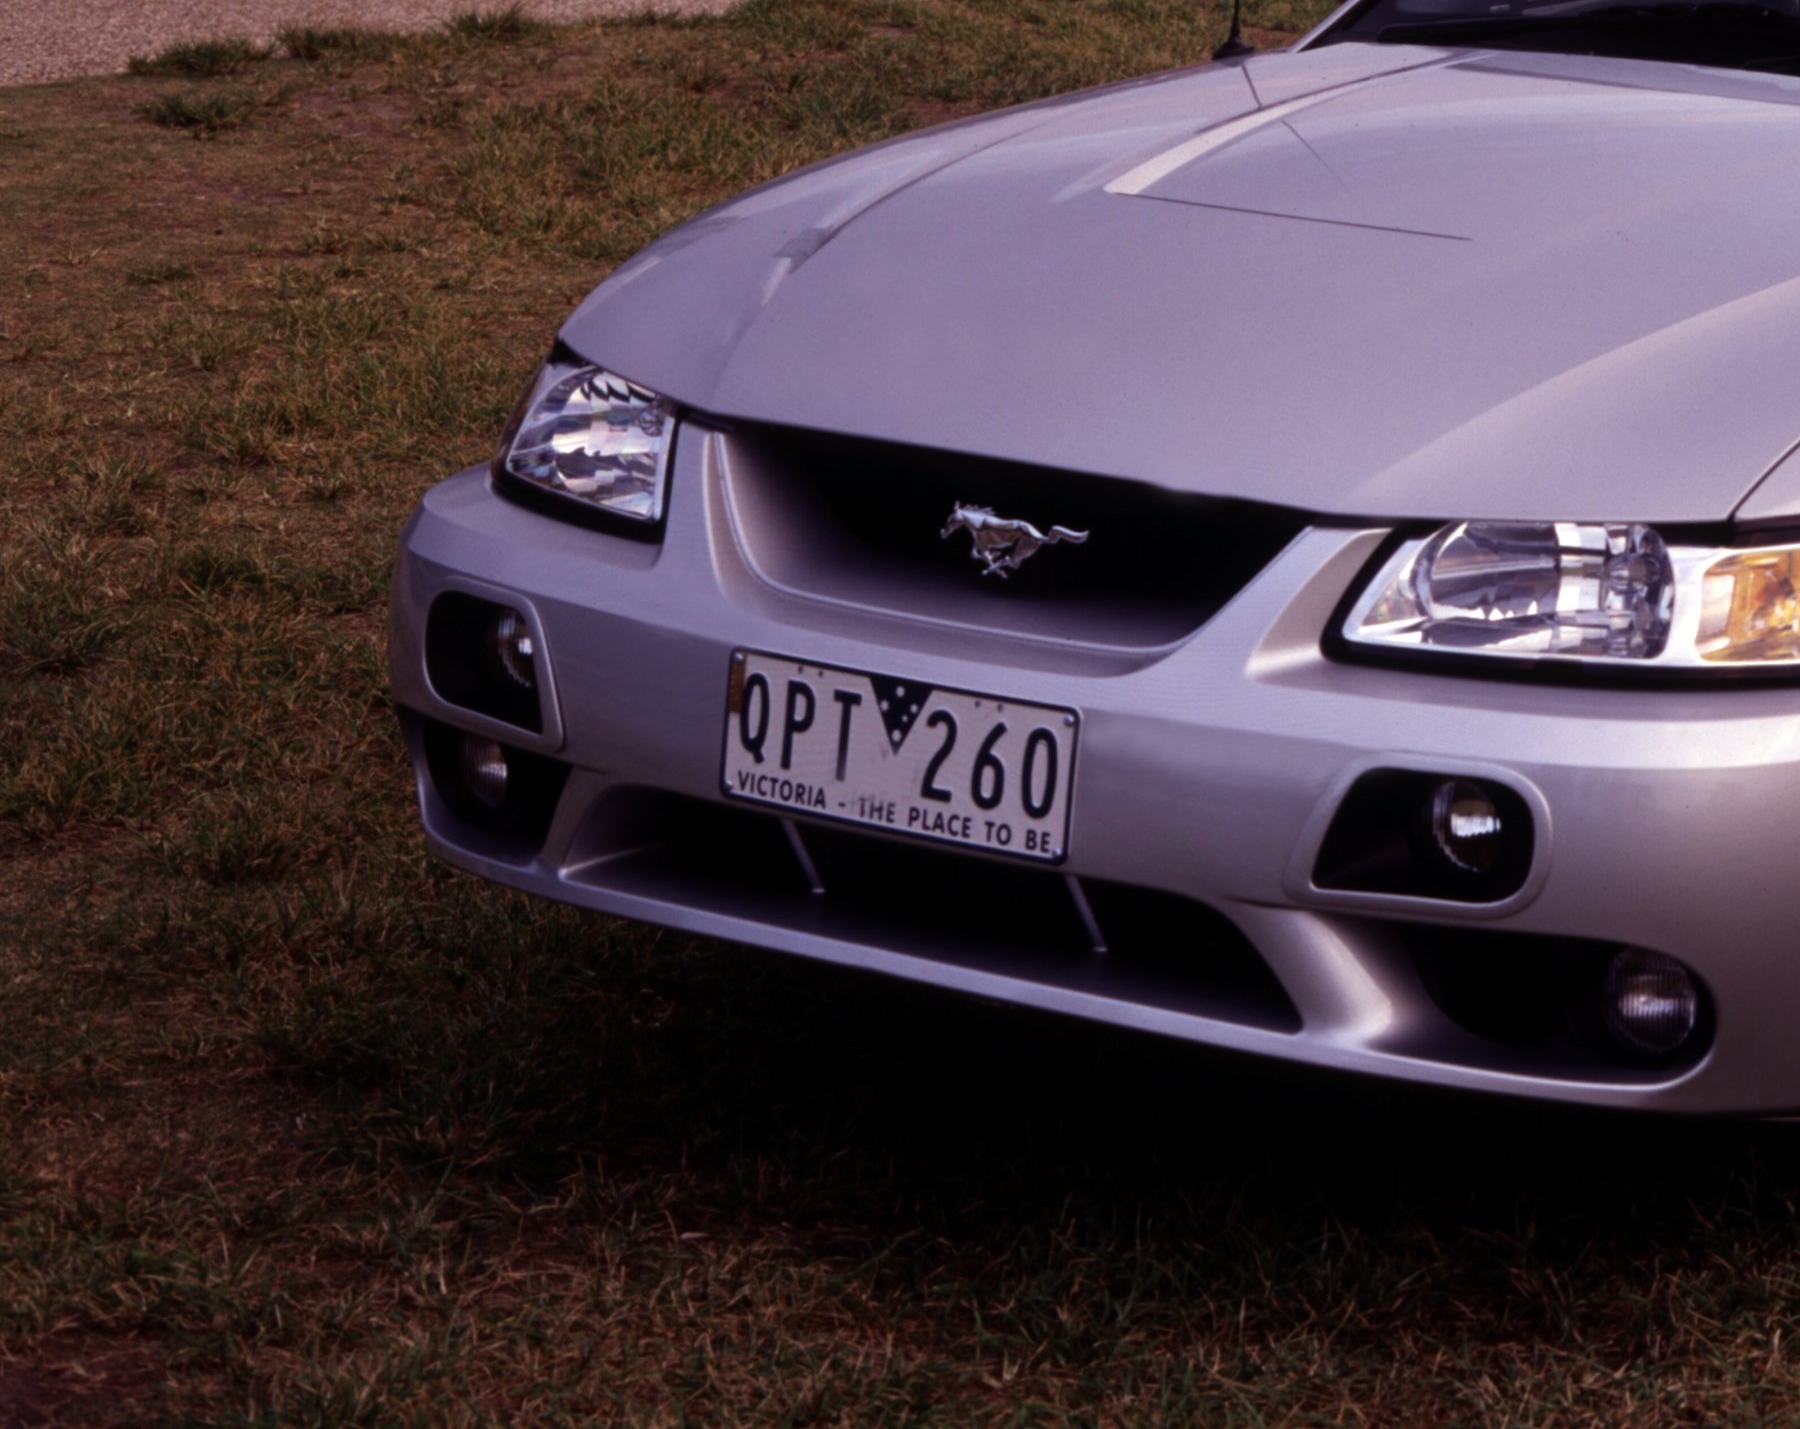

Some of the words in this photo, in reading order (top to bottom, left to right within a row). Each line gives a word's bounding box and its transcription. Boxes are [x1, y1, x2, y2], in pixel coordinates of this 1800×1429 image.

[740, 673, 862, 782] QPT
[920, 709, 1058, 819] 260
[737, 770, 826, 810] VICTORIA
[858, 797, 896, 824] THE
[907, 806, 971, 839] PLACE
[985, 821, 1012, 846] TO
[1025, 832, 1051, 854] BE
